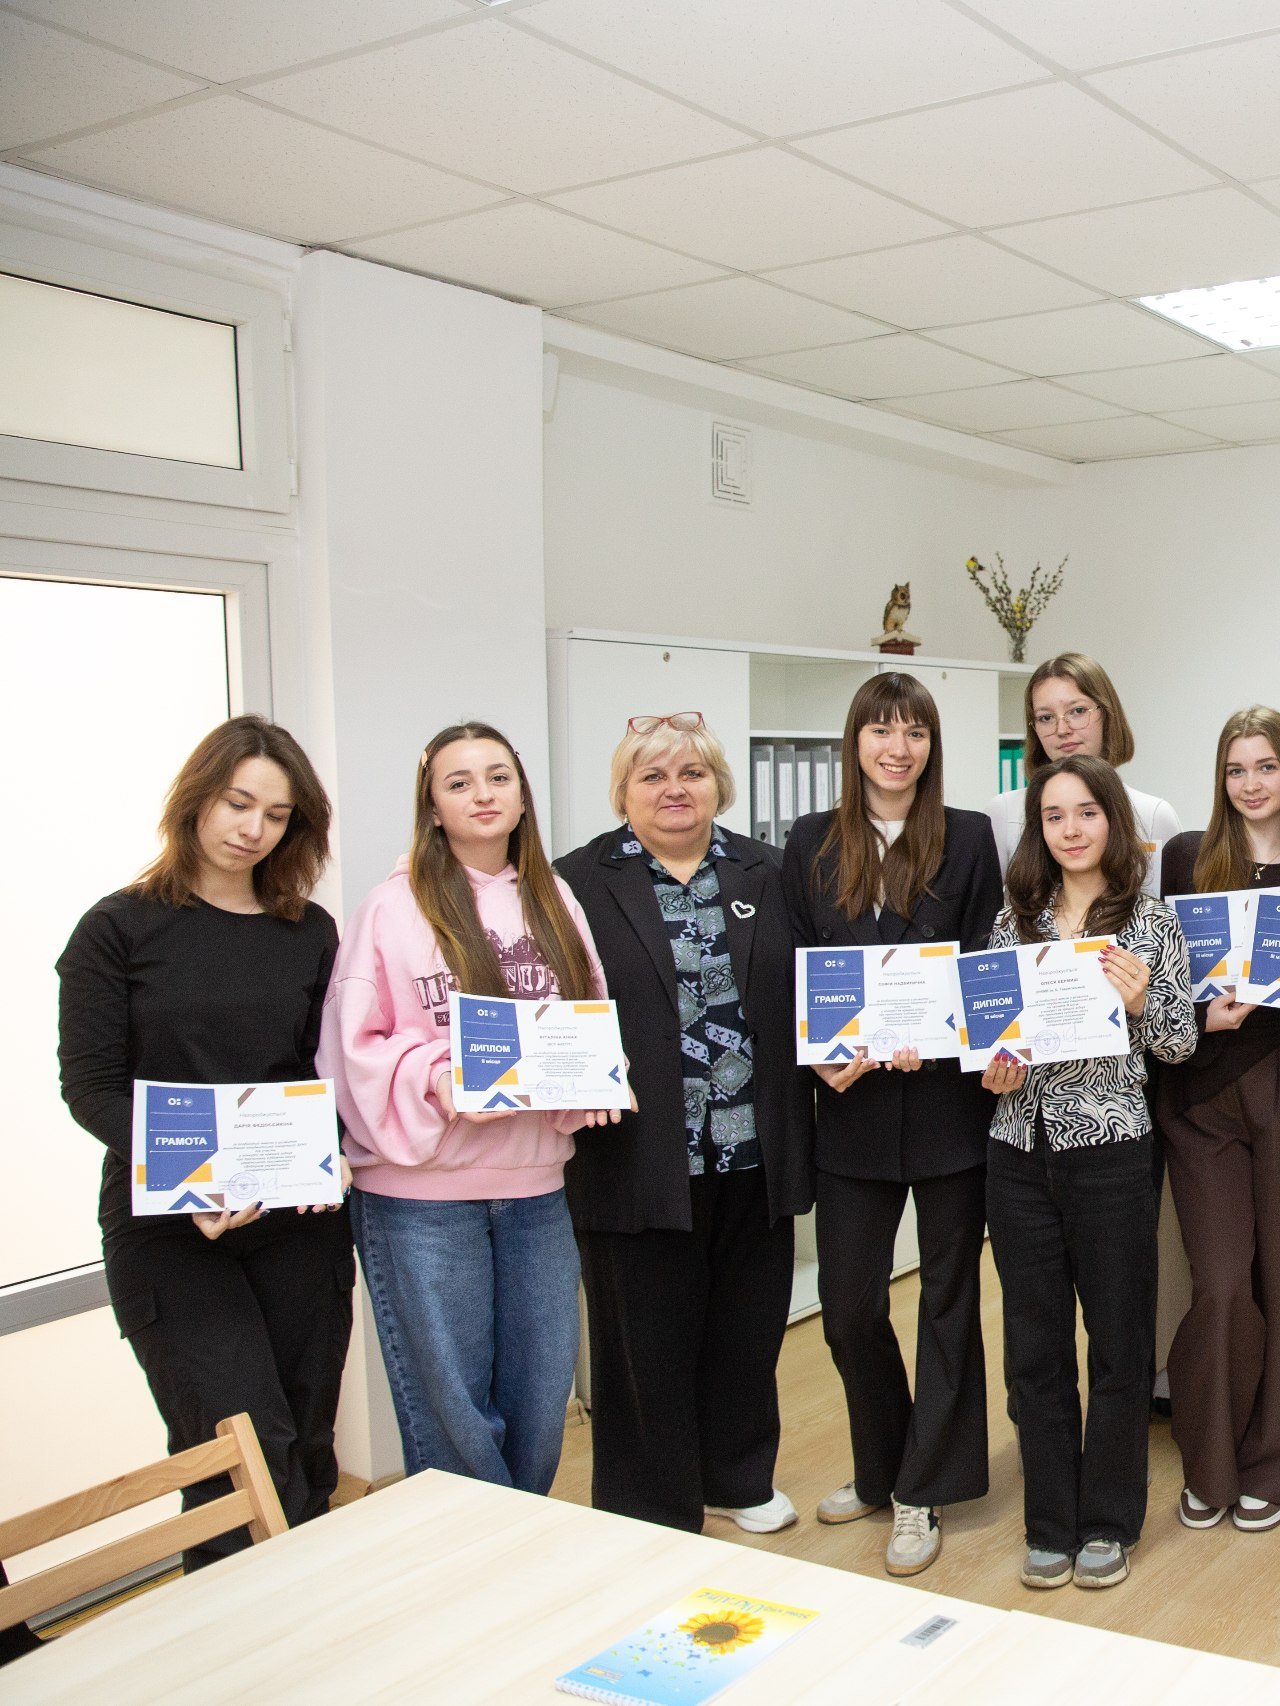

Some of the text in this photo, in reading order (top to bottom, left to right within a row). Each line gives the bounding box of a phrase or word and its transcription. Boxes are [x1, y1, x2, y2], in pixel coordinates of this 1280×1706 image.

[1186, 937, 1222, 949] ДИПЛОМ
[814, 995, 857, 1004] ГРАМОТА
[972, 997, 1013, 1011] ДИПЛОМ
[469, 1043, 511, 1053] ДИПЛОМ
[154, 1136, 208, 1147] ГРАМОТА
